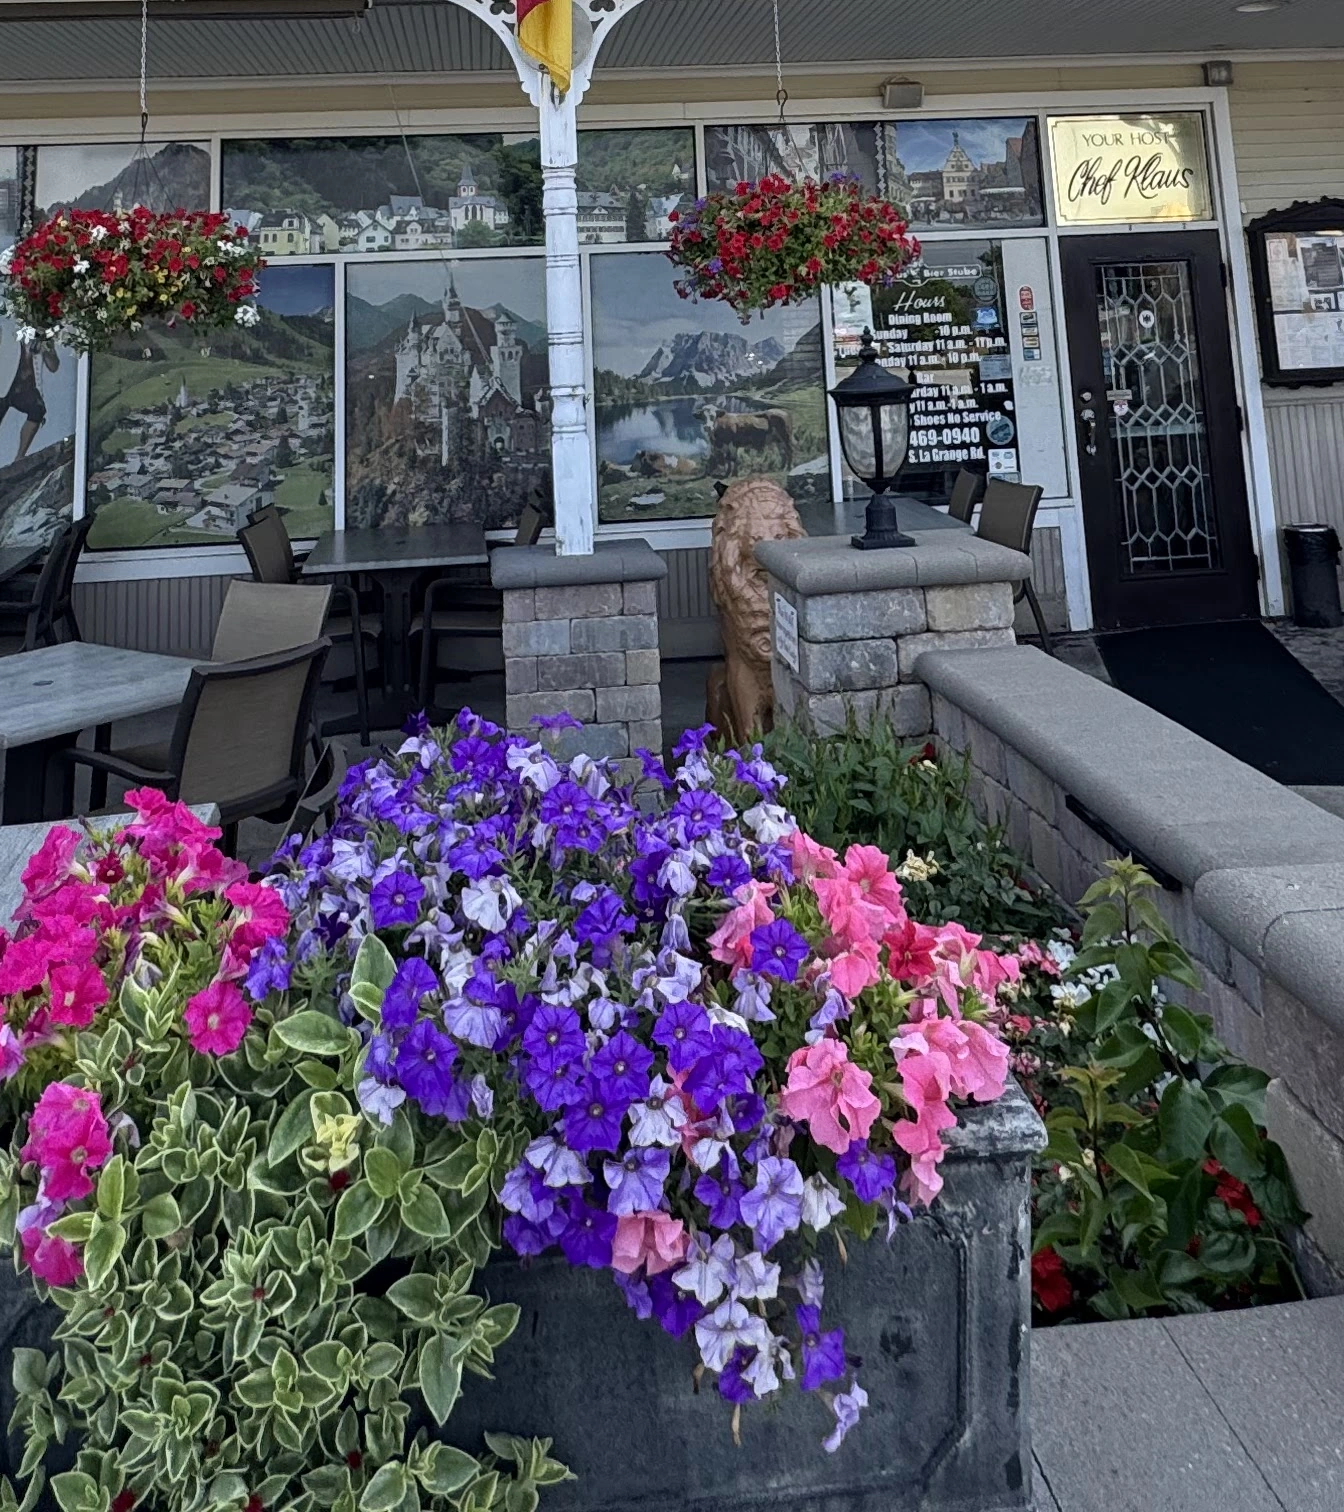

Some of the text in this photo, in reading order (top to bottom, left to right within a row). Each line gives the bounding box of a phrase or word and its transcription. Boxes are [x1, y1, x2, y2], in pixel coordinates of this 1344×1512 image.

[1082, 131, 1169, 147] YOUR HOST
[1068, 152, 1194, 205] Chef Klaus
[923, 270, 945, 278] Bier
[947, 266, 977, 276] Stube
[892, 290, 945, 311] Hours
[888, 313, 953, 326] Dining Room
[887, 340, 934, 354] Saturday
[875, 355, 906, 368] onday
[913, 414, 946, 426] Shoes
[947, 412, 961, 425] No
[962, 410, 1002, 424] Service
[909, 426, 980, 447] 469-0940
[919, 448, 931, 463] La
[932, 448, 969, 463] Grange
